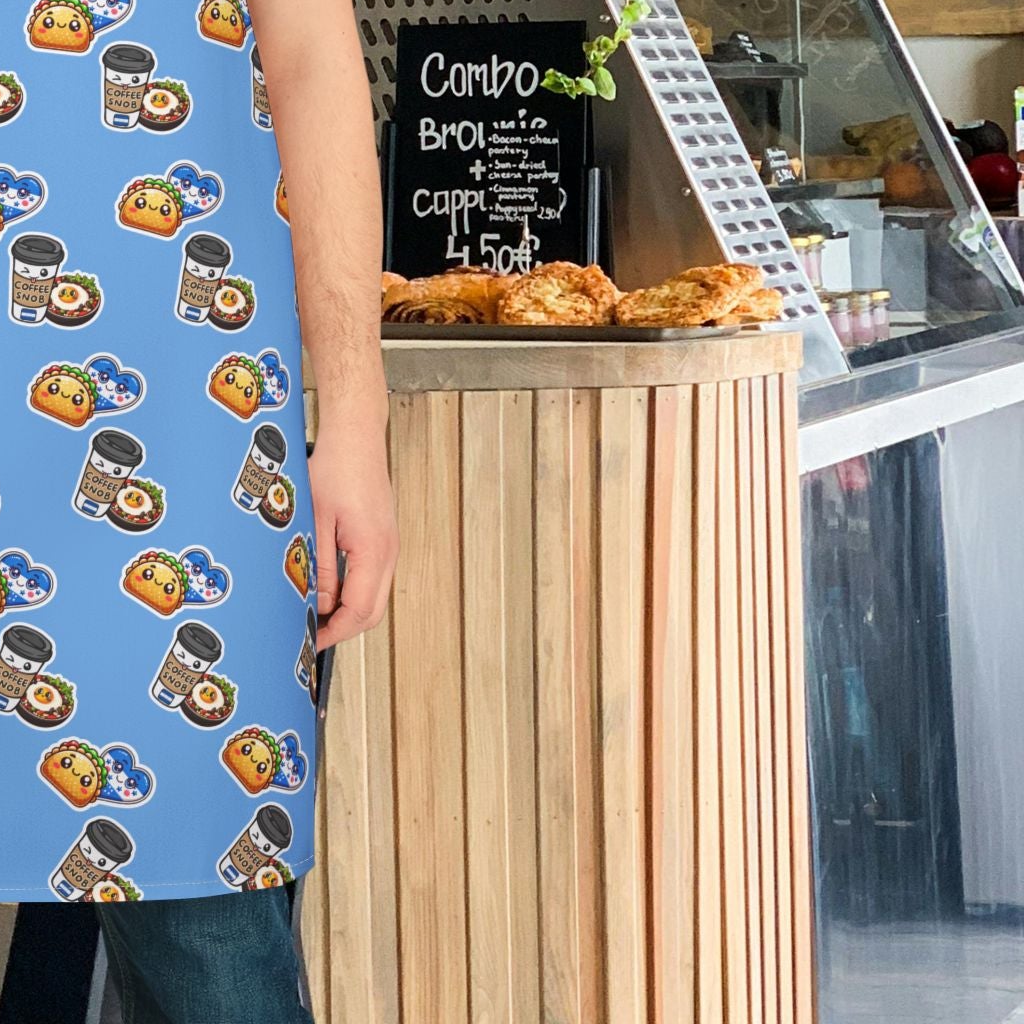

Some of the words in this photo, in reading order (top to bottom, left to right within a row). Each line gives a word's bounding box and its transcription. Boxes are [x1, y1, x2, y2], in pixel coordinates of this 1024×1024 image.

[421, 52, 539, 99] Combo
[107, 89, 141, 99] COFFEE
[109, 98, 137, 108] SNOB
[15, 281, 49, 293] COFFEE
[184, 278, 214, 294] COFFEE
[184, 289, 209, 303] SNOB
[17, 292, 44, 303] SNOB
[86, 471, 117, 491] COFFEE
[242, 475, 263, 494] SNOB
[245, 464, 270, 487] COFFEE
[84, 483, 111, 500] SNOB
[162, 672, 185, 692] SNOB
[166, 661, 195, 684] COFFEE
[234, 849, 253, 872] SNOB
[238, 839, 262, 866] COFFEE
[65, 863, 88, 887] SNOB
[70, 854, 98, 882] COFFEE
